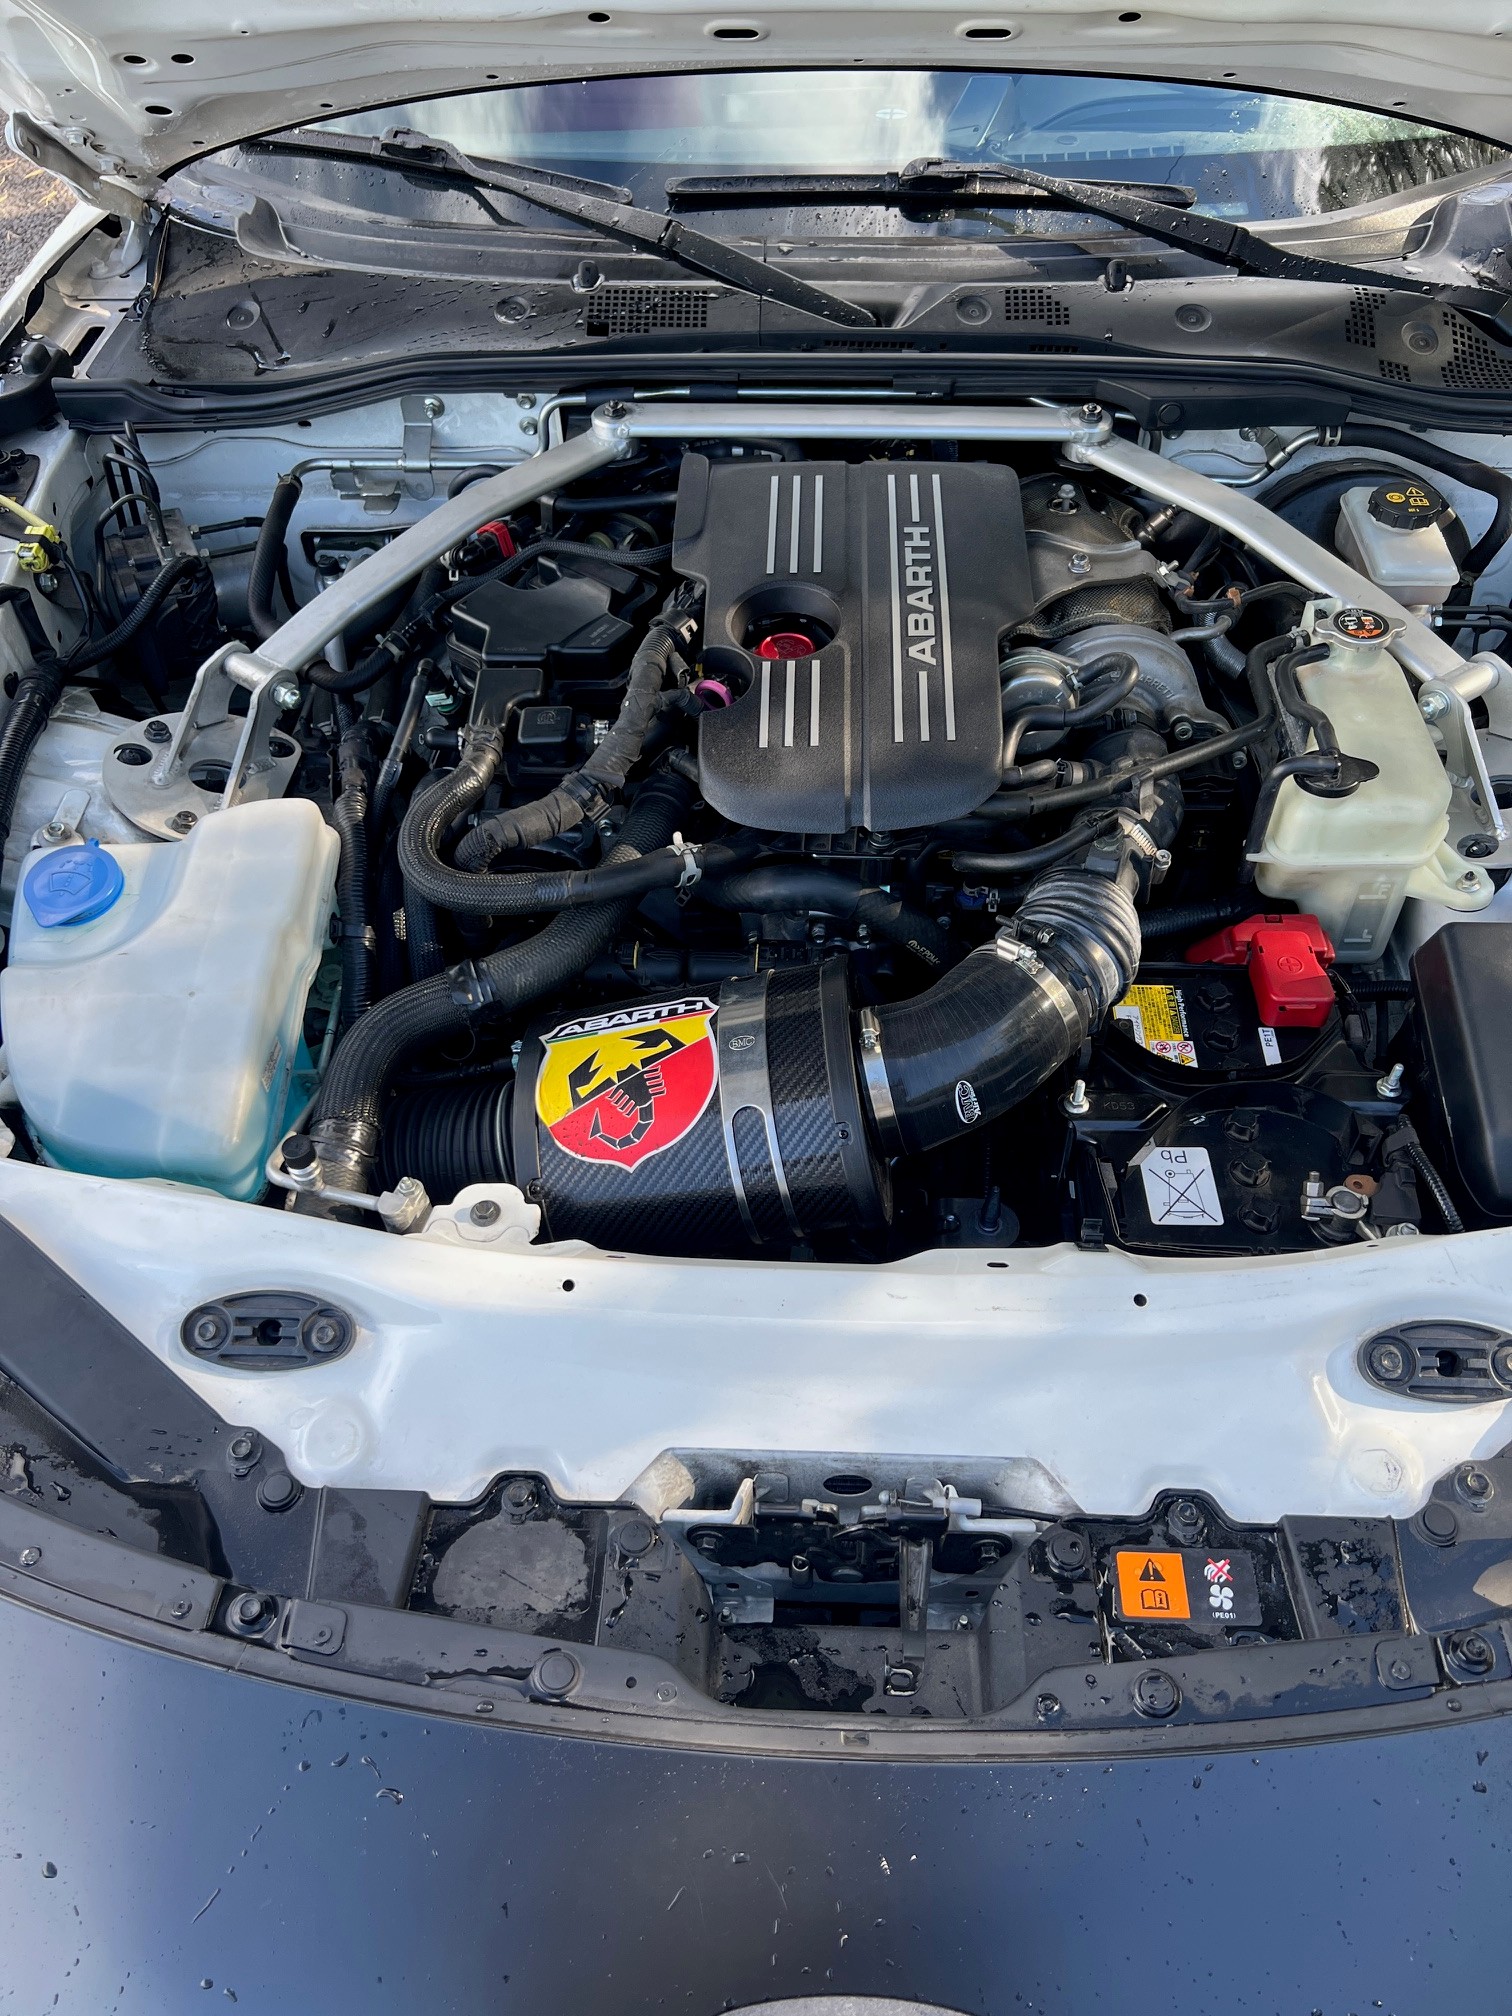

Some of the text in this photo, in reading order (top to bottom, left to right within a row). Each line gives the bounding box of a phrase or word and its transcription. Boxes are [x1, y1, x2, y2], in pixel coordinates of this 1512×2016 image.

[903, 527, 937, 666] ABARTH
[557, 1001, 704, 1037] ABARTH
[1175, 989, 1190, 1038] High Performance
[732, 1036, 753, 1049] BMC
[1262, 1029, 1274, 1048] PE1T
[958, 1083, 976, 1121] BMC
[1103, 1101, 1136, 1112] KD53
[1160, 1149, 1188, 1164] Pb
